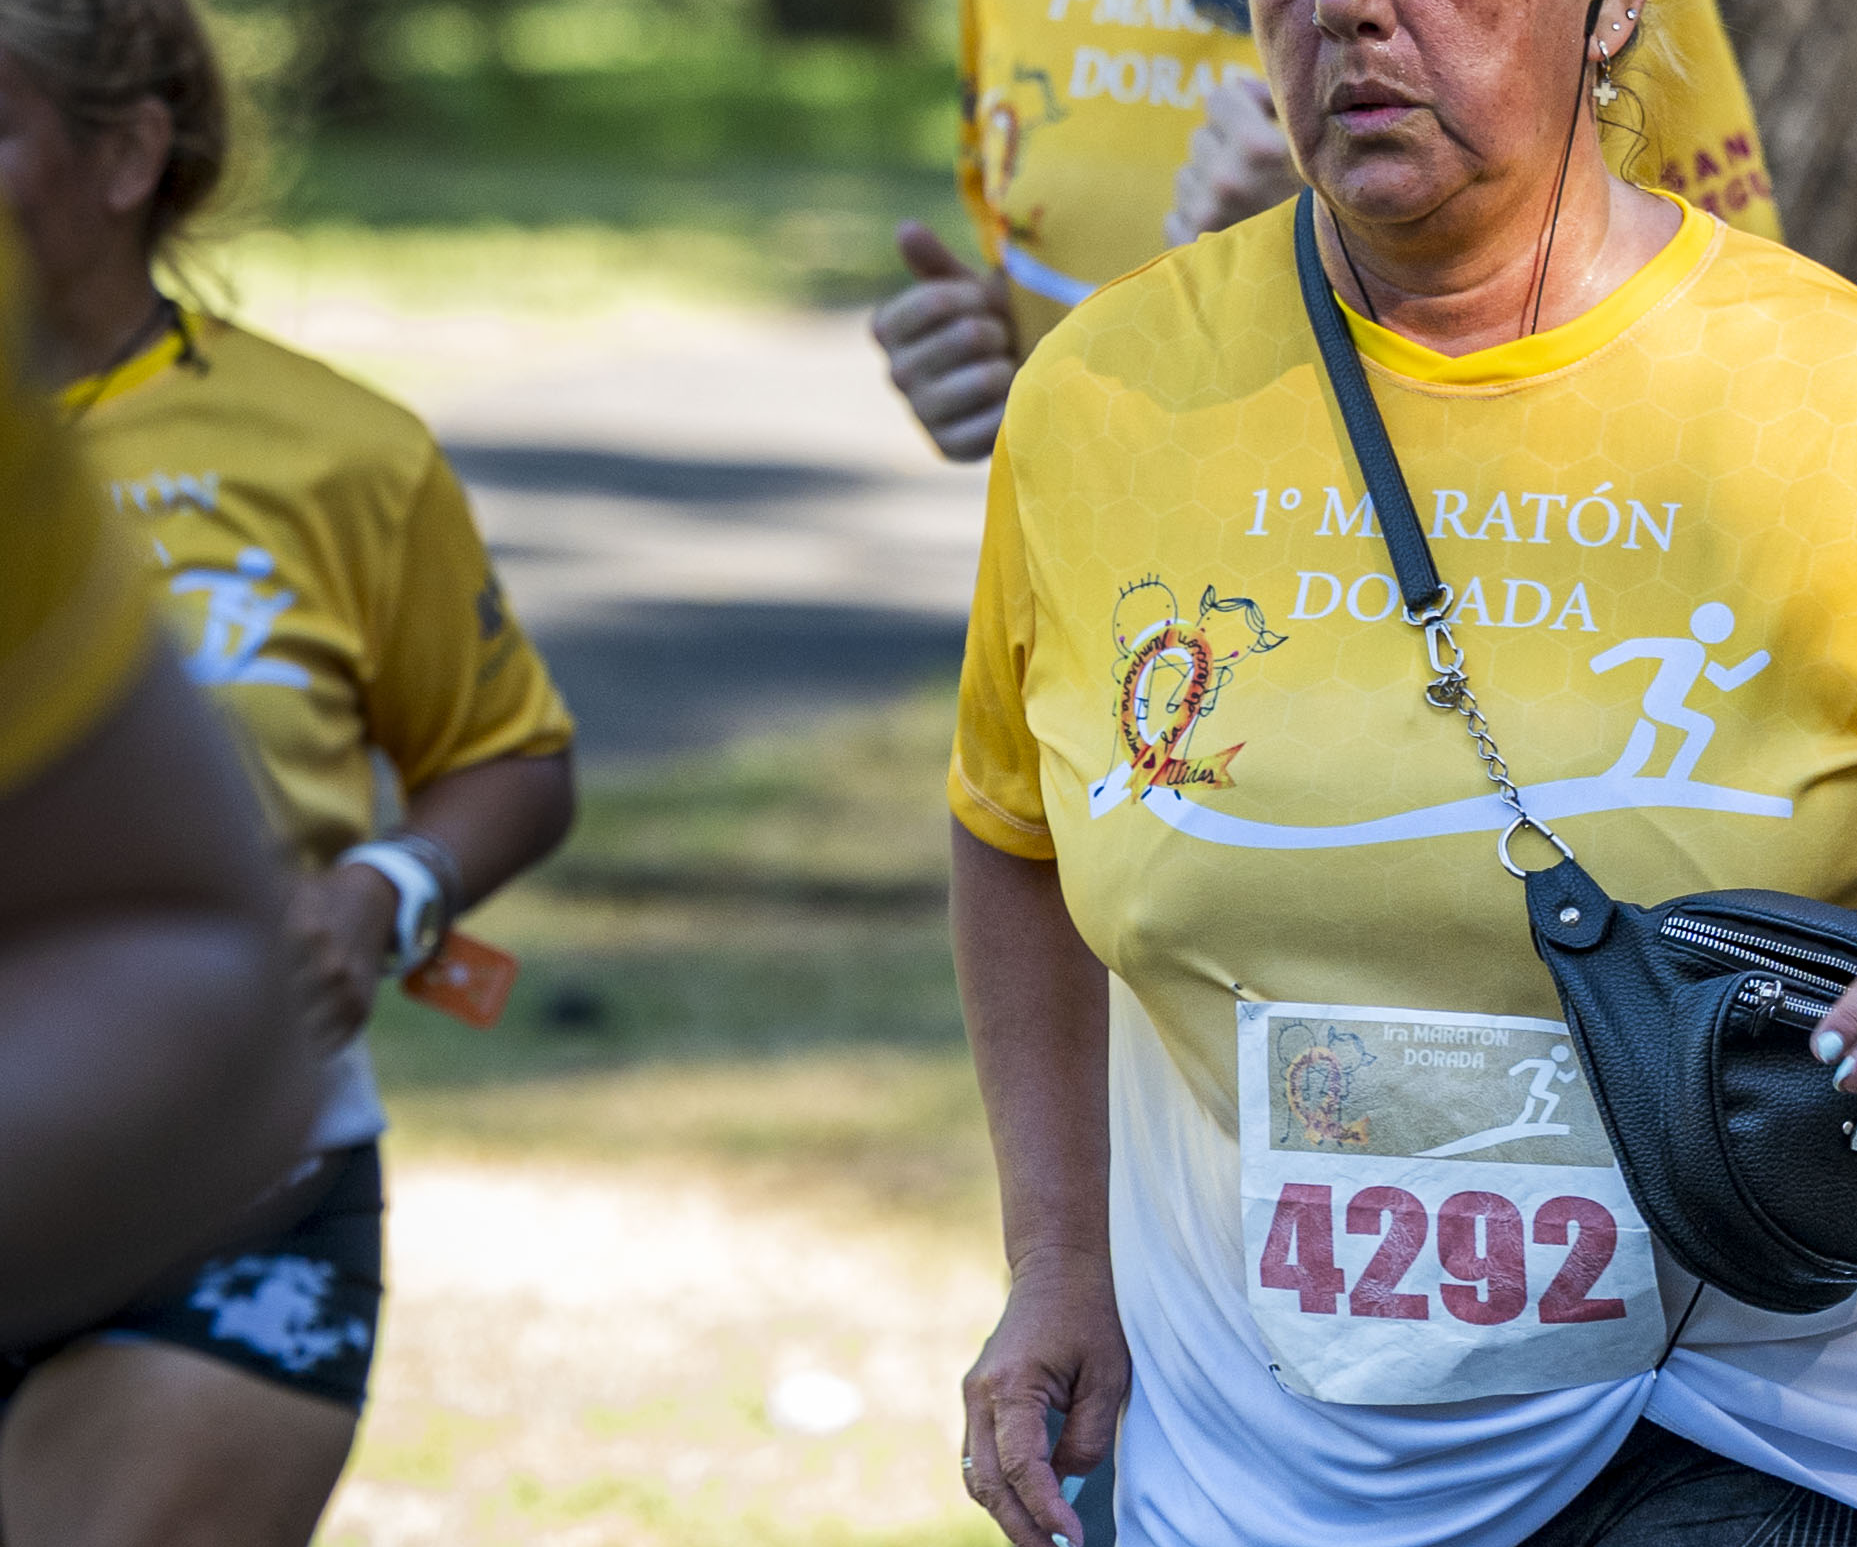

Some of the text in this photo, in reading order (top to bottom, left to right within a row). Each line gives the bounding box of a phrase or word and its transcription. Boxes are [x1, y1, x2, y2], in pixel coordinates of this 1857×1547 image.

[1315, 481, 1683, 552] MRATÓN
[1287, 570, 1600, 633] DOADA
[1404, 1049, 1485, 1069] DORADA
[1260, 1183, 1627, 1326] 4292
